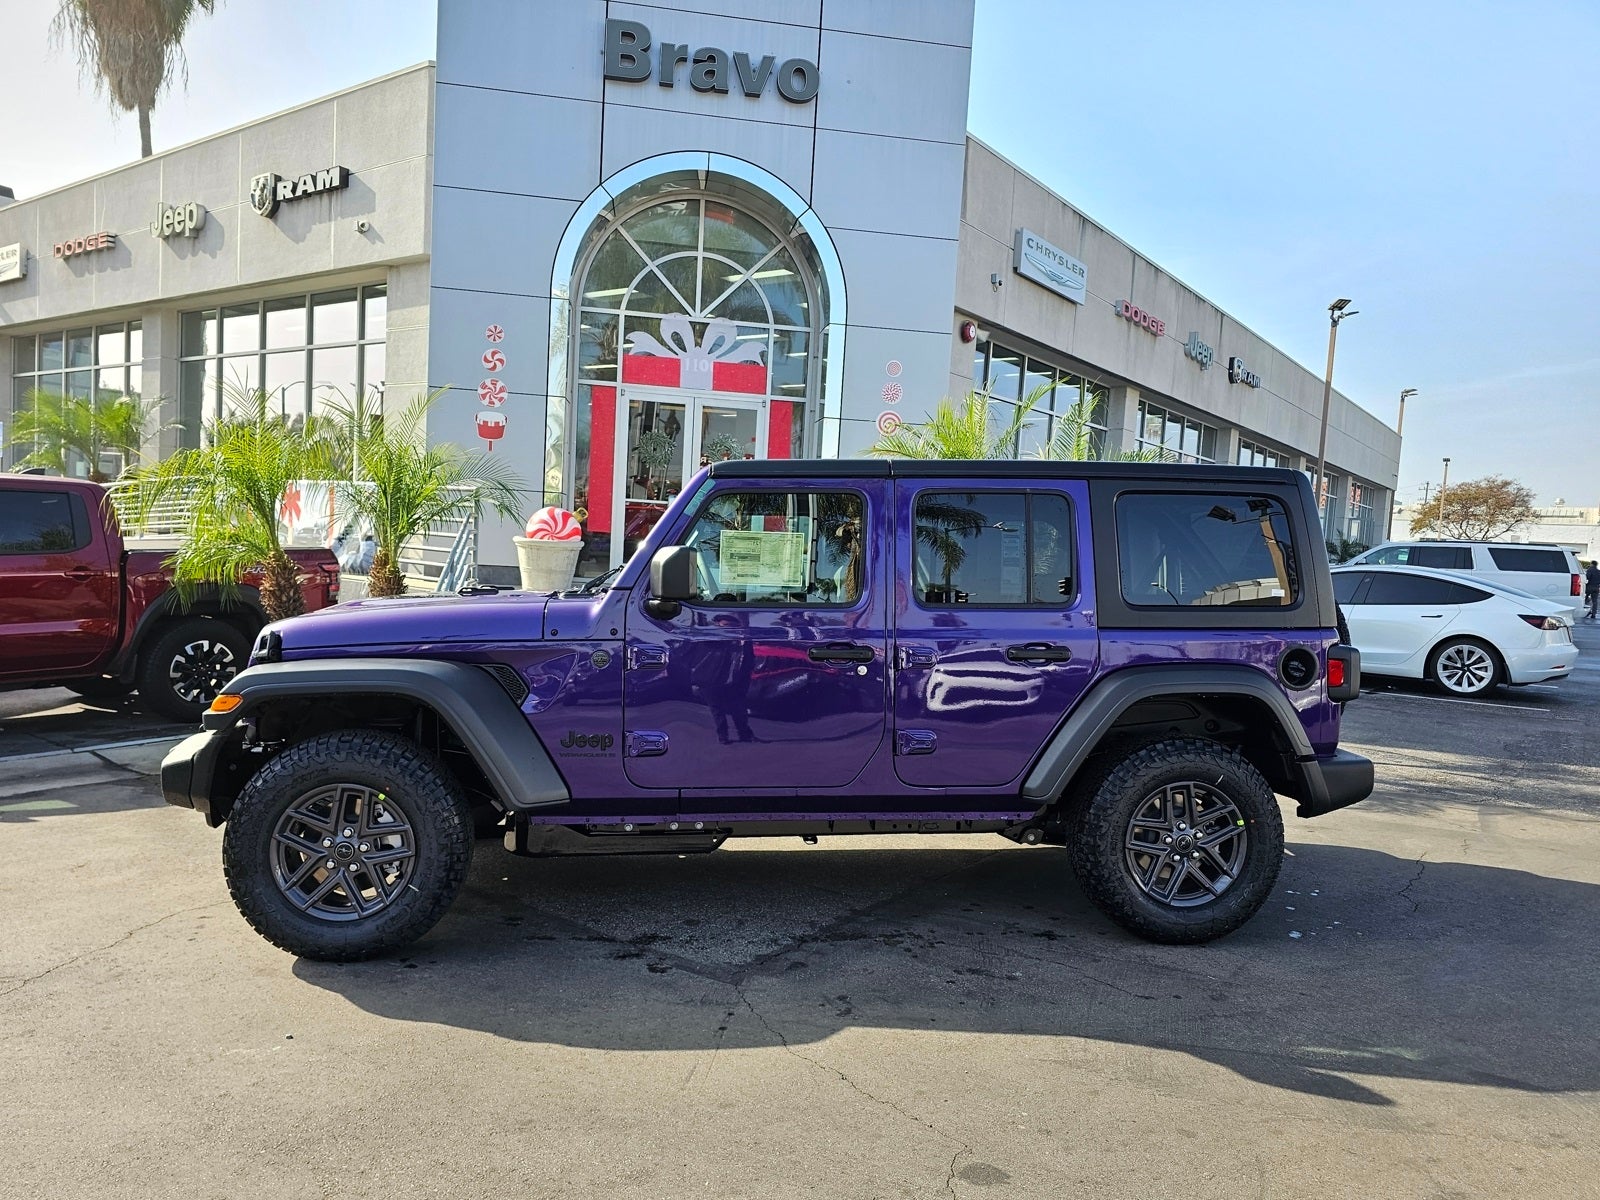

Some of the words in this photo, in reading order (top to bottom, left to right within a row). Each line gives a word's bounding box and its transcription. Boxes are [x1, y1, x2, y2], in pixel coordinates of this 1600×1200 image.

[604, 17, 820, 104] Bravo
[276, 166, 345, 203] RAM
[150, 202, 203, 238] Jeep
[54, 232, 113, 258] DODGE
[1026, 237, 1085, 278] CHRYSLER
[1120, 299, 1165, 337] DODGE
[684, 358, 709, 371] 110
[1186, 332, 1213, 370] Jeep
[1241, 368, 1261, 388] RAM
[560, 730, 614, 751] Jeep
